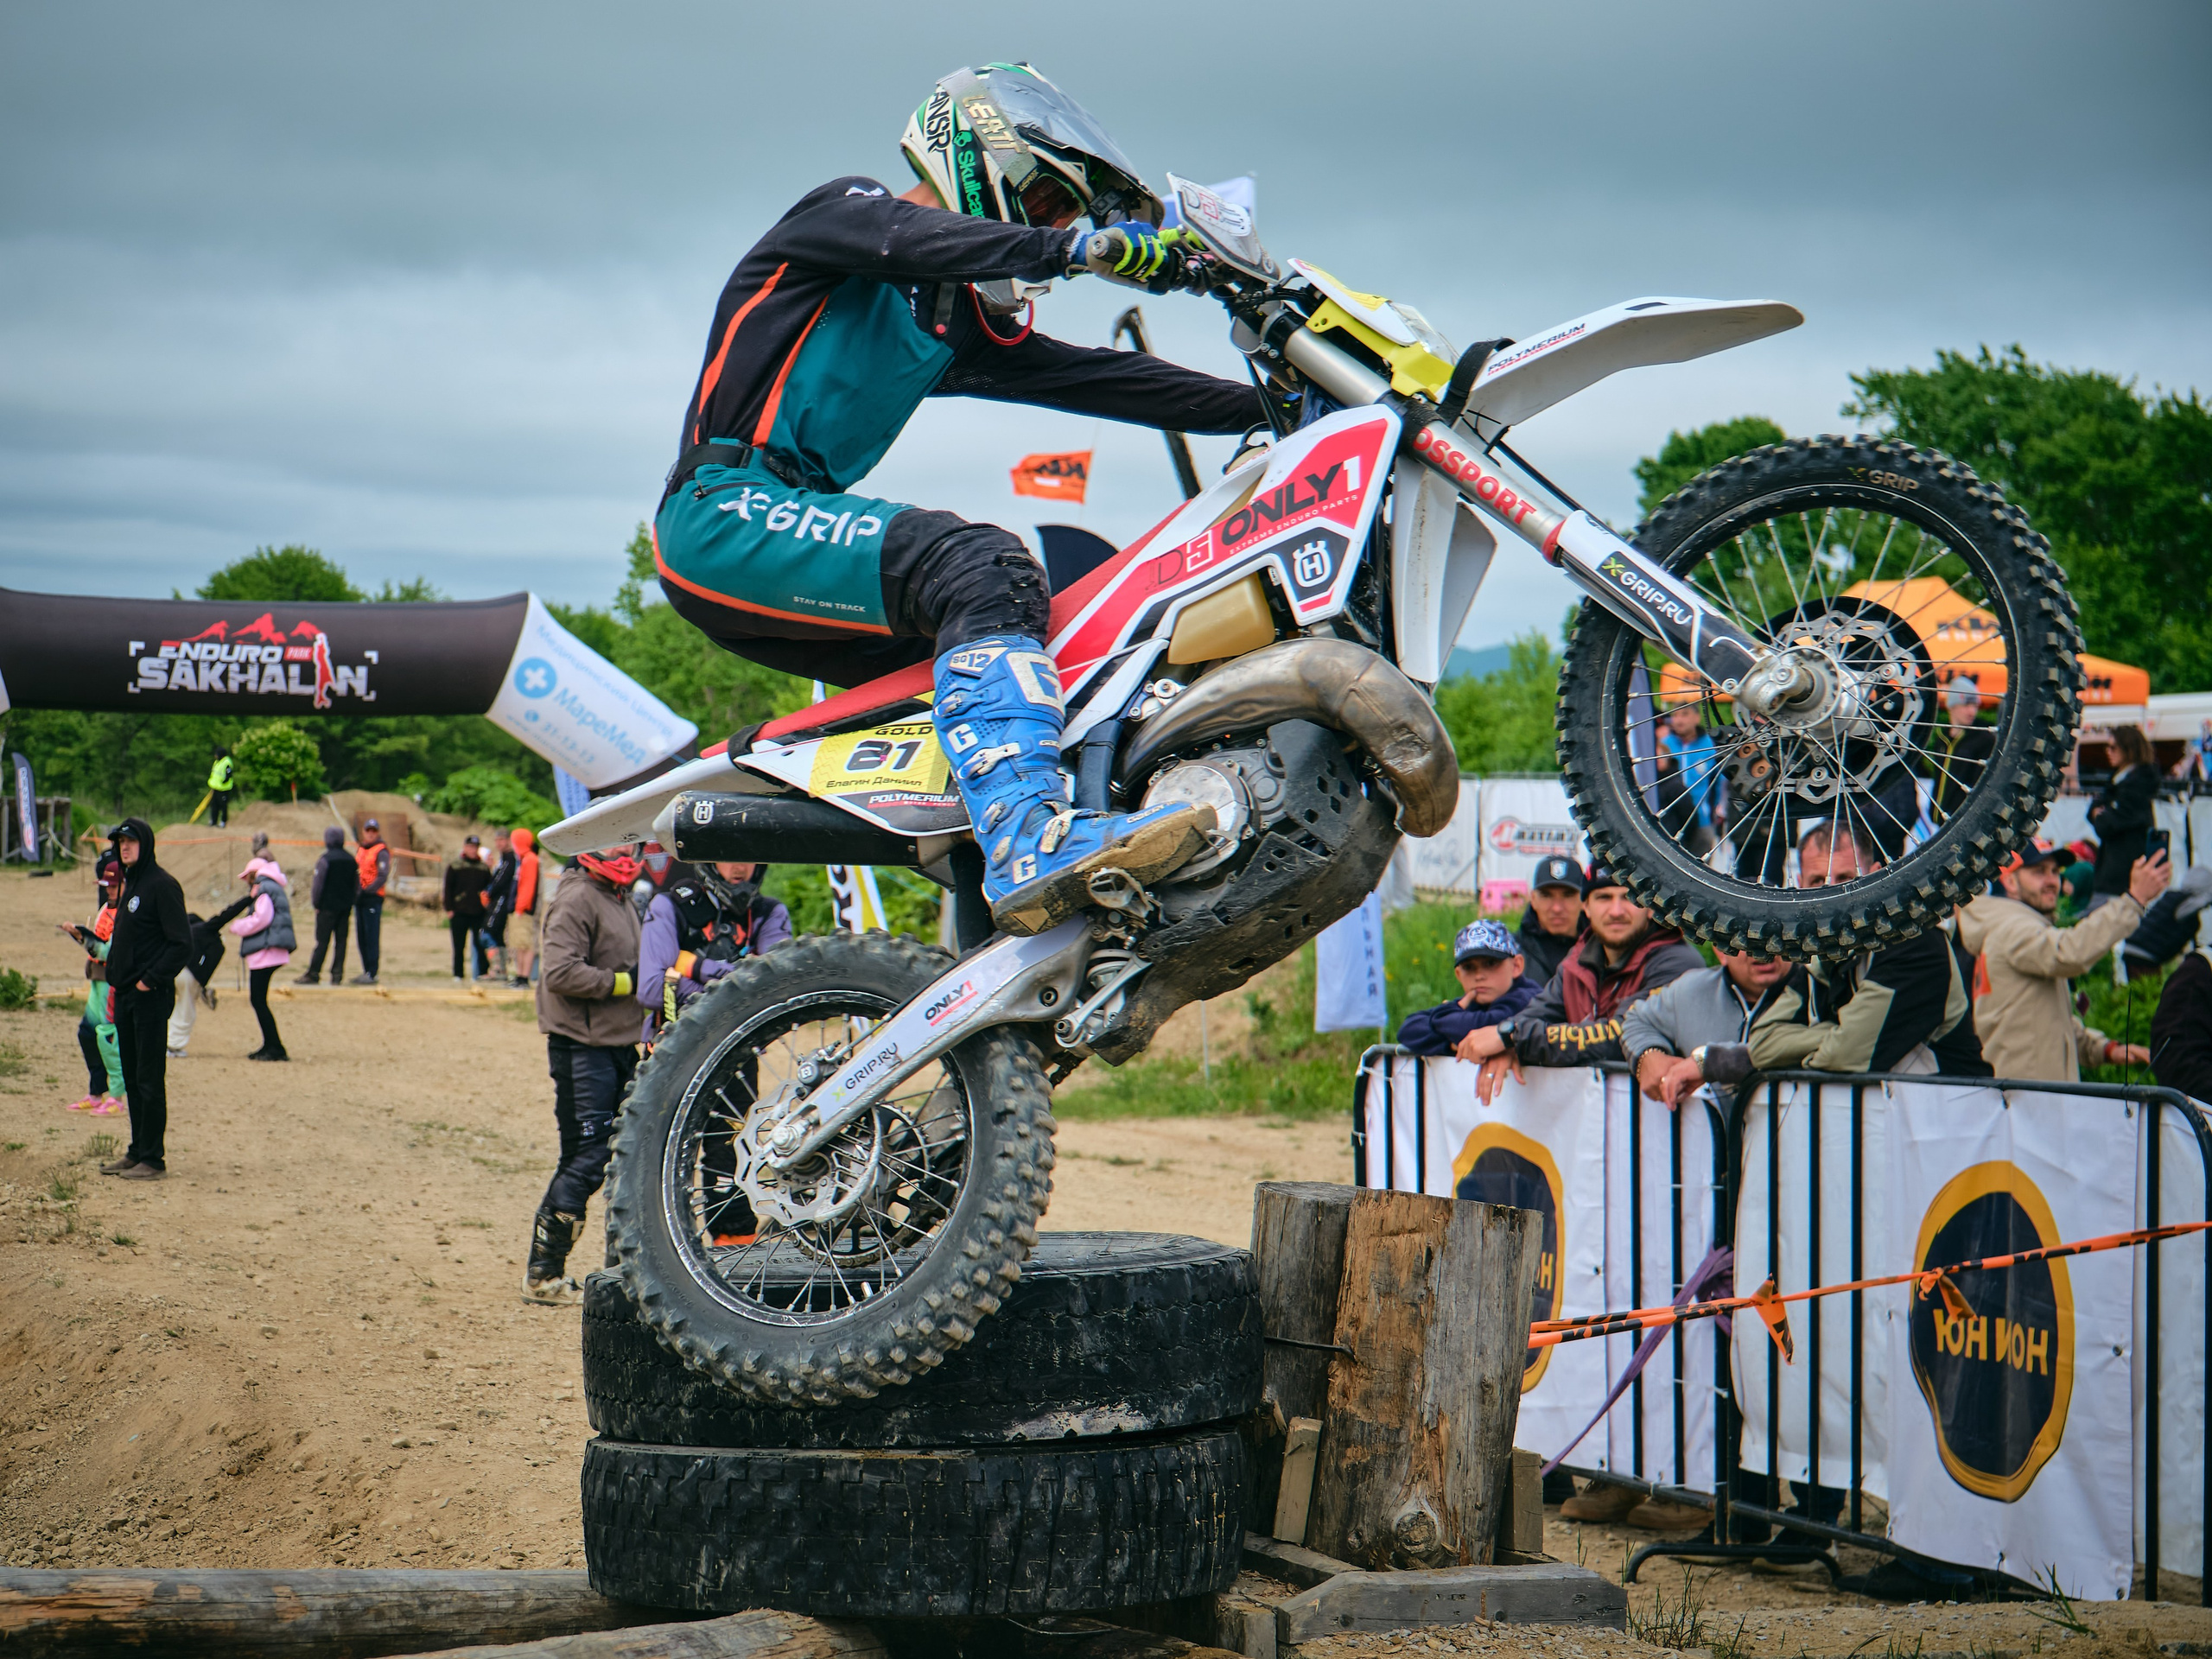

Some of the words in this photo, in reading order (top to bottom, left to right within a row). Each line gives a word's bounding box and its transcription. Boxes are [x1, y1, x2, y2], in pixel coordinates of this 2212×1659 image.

[963, 95, 1023, 154] LEATT
[717, 487, 883, 547] X-GRIP
[1230, 528, 1274, 556] EXTREME
[1276, 509, 1319, 531] ENDURO
[1322, 494, 1359, 512] PARTS
[793, 595, 817, 606] STAY
[834, 602, 866, 613] TRACK
[1602, 556, 1693, 625] X-GRIP.RU
[158, 640, 283, 664] ENDURO
[553, 688, 646, 766] МареМед
[875, 726, 934, 735] GOLD
[826, 778, 870, 788] Елагин
[872, 776, 923, 787] Даниил
[869, 792, 961, 804] POLYMERIUM
